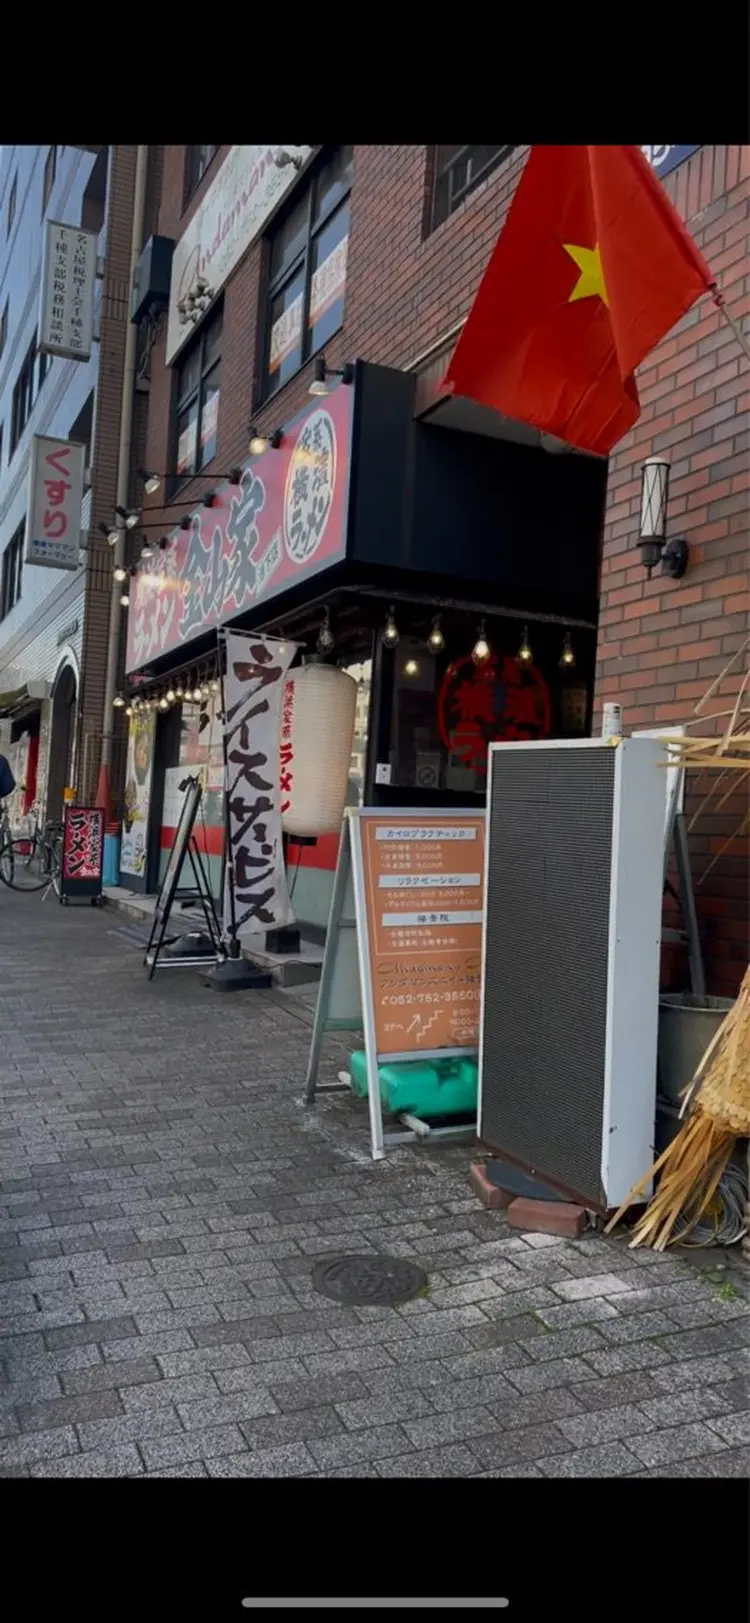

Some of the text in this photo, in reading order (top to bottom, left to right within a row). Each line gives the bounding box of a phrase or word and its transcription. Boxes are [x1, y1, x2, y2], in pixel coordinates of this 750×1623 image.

[49, 230, 68, 343] 千種支部税務相談所
[69, 234, 87, 349] 名古屋税理士会千種支部
[42, 447, 72, 538] くすり
[178, 467, 266, 640] 金山家
[133, 591, 176, 666] ラーメン
[65, 808, 88, 876] ラーメン
[220, 644, 284, 934] ライスサービス
